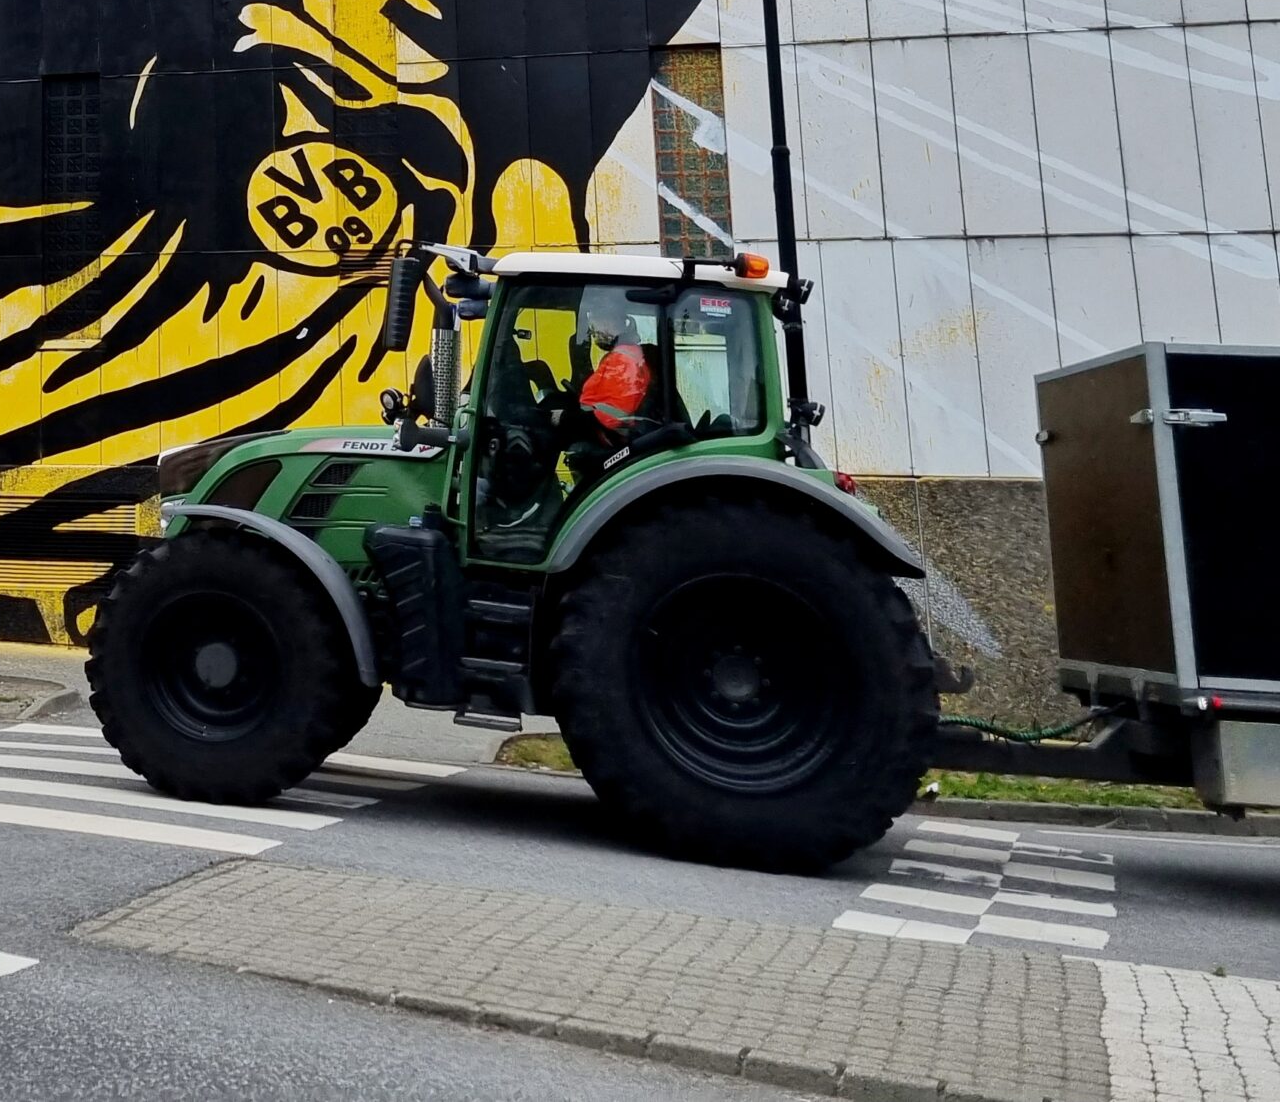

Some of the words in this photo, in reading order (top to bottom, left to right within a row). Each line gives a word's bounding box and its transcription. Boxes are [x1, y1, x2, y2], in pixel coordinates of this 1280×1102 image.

[256, 148, 382, 249] BVB
[324, 215, 374, 256] 09
[342, 441, 388, 451] FENDT
